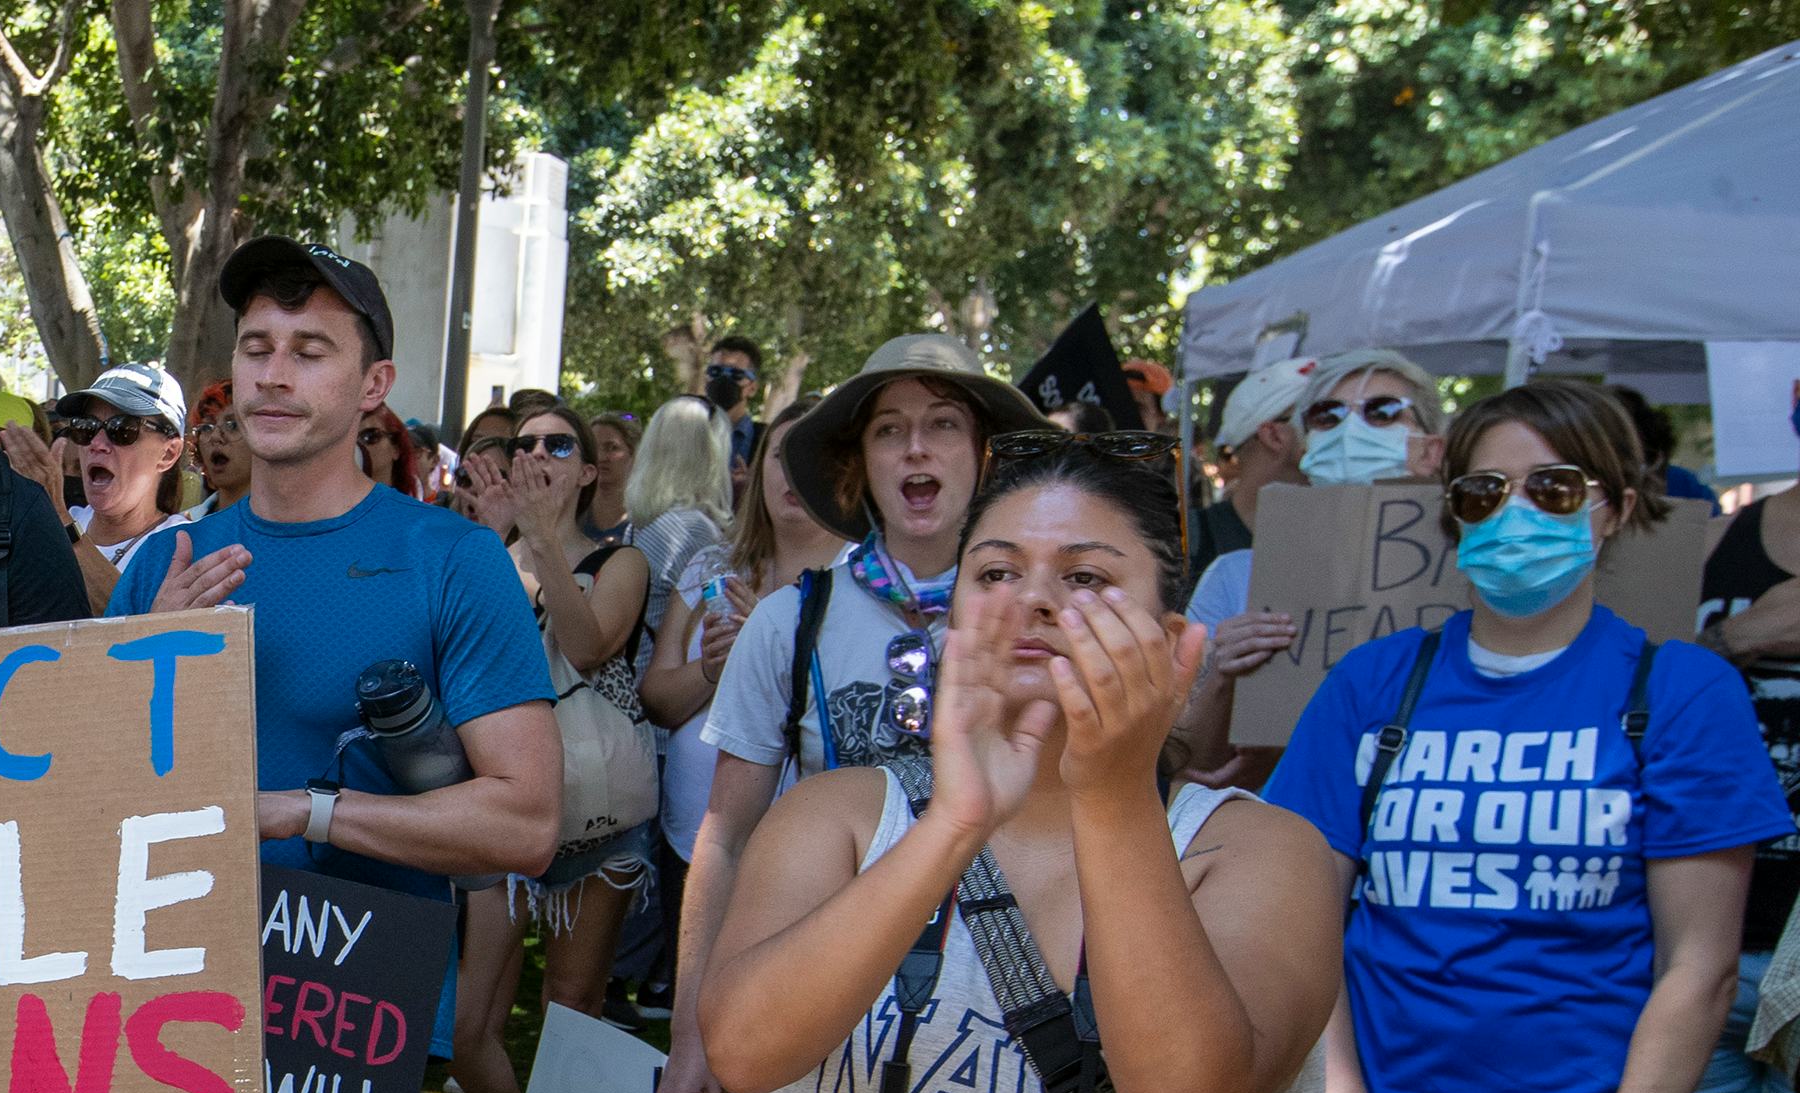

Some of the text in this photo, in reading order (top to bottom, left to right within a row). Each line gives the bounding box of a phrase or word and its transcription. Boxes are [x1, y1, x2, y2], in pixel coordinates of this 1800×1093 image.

[1366, 787, 1633, 847] OR OUR
[1355, 850, 1521, 910] IVES
